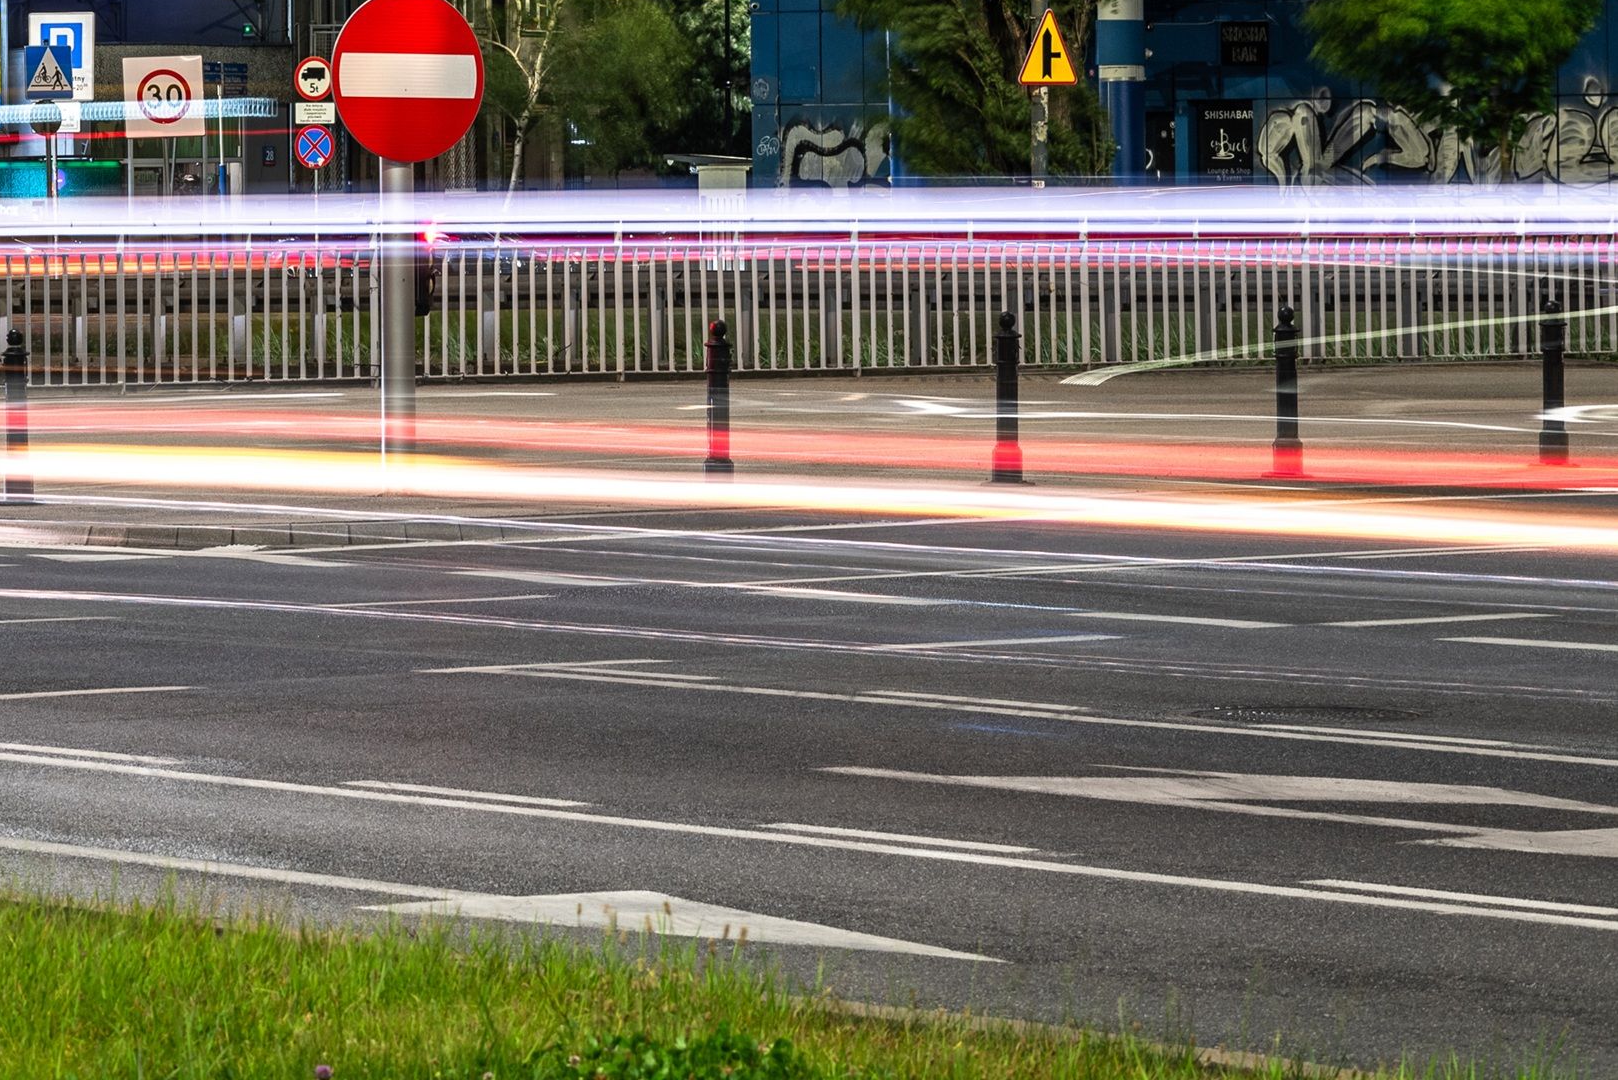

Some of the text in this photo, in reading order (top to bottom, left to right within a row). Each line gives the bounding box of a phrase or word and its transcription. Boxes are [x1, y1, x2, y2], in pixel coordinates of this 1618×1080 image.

[146, 83, 183, 109] 30
[1204, 110, 1254, 120] SHISHABAR
[265, 150, 275, 161] 28
